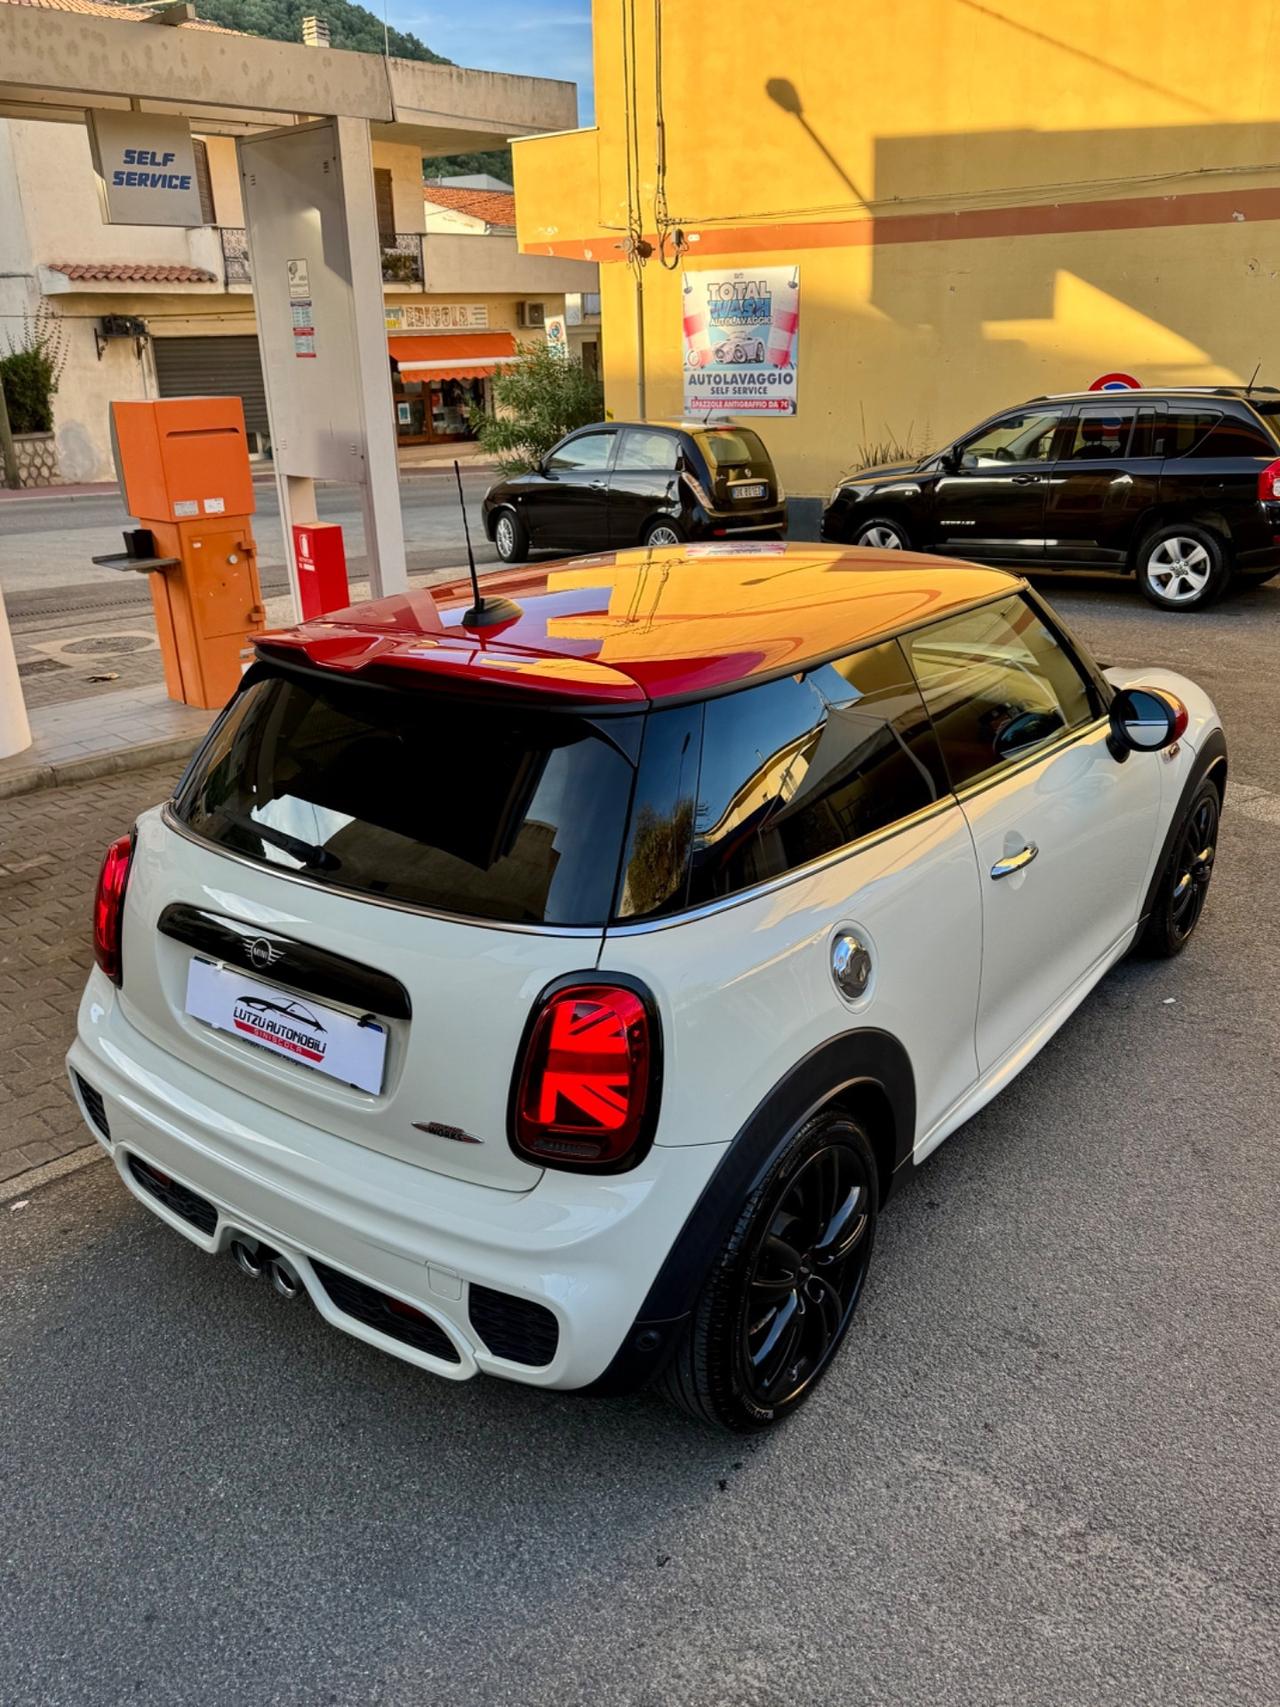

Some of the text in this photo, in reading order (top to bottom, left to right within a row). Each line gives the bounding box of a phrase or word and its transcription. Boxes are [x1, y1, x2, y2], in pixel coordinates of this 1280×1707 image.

[123, 149, 175, 167] SELF
[112, 170, 192, 190] SERVICE
[707, 280, 772, 301] TOTAL
[708, 297, 771, 318] WASH
[709, 315, 774, 327] AUTOLAVAGGIO
[688, 372, 794, 385] AUTOLAVAGGIO
[710, 386, 768, 395] SELF SERVICE
[768, 400, 779, 408] DA
[253, 947, 268, 960] MINI
[233, 1006, 267, 1028] LUTZU
[253, 1027, 303, 1054] SINISCOLA
